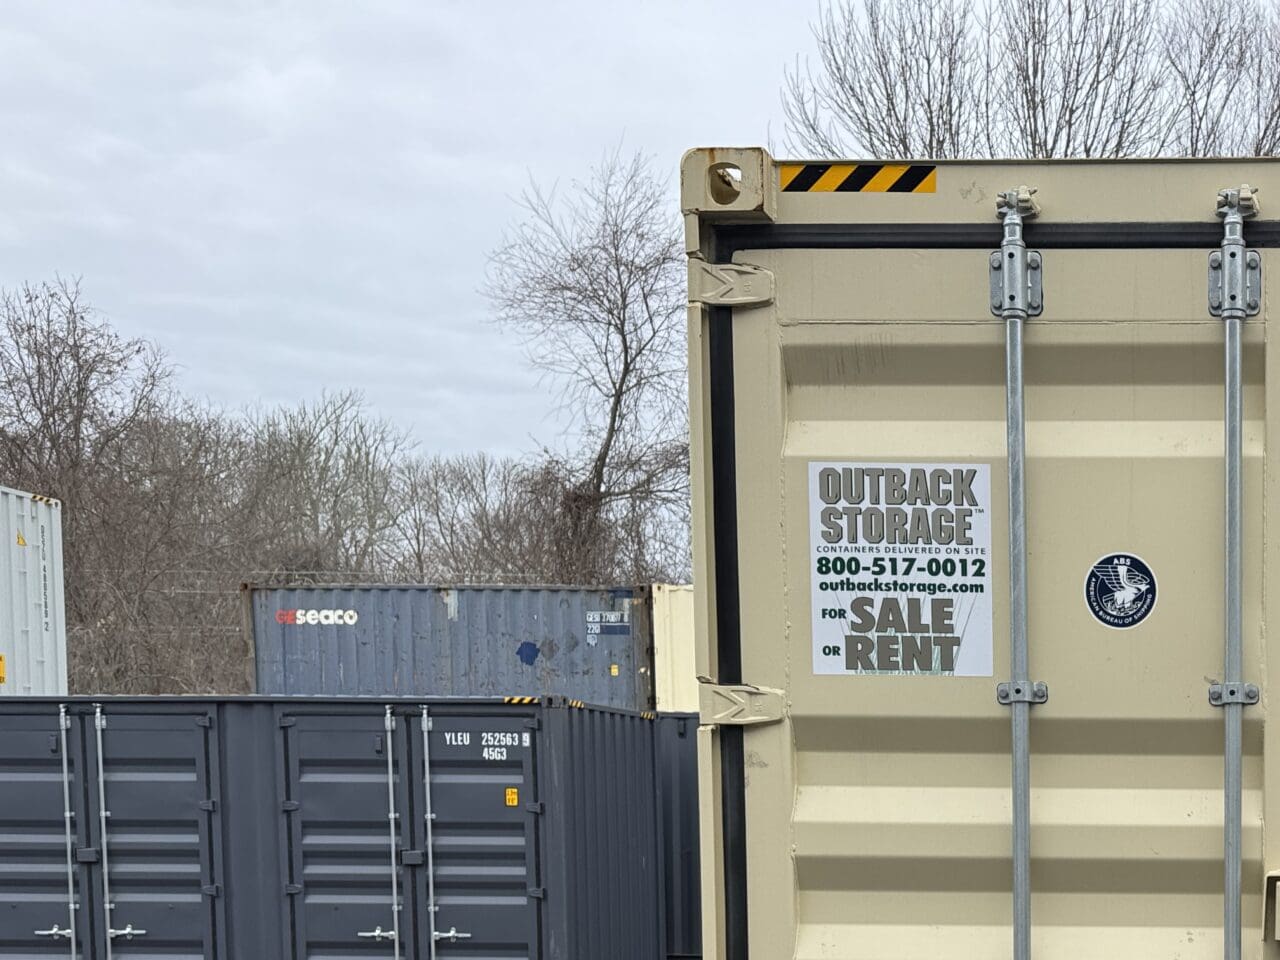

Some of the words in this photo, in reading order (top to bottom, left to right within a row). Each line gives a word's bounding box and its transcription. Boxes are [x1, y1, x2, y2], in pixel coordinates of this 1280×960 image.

[818, 467, 978, 506] OUTBACK
[820, 507, 973, 545] STORAGE
[816, 545, 881, 554] CONTAINERS
[884, 546, 941, 554] DELIVERED
[945, 547, 960, 555] ON
[964, 547, 986, 555] SITE
[816, 556, 986, 577] 800-517-0012
[1113, 557, 1131, 566] ABS
[819, 578, 984, 595] outbackstorage.com
[821, 608, 847, 619] FOR
[850, 596, 954, 634] SALE
[1098, 611, 1123, 624] BUREAU
[822, 646, 841, 656] OR
[844, 635, 961, 671] RENT
[444, 732, 470, 745] YLEU
[481, 732, 519, 746] 252563
[482, 747, 507, 760] 45G3
